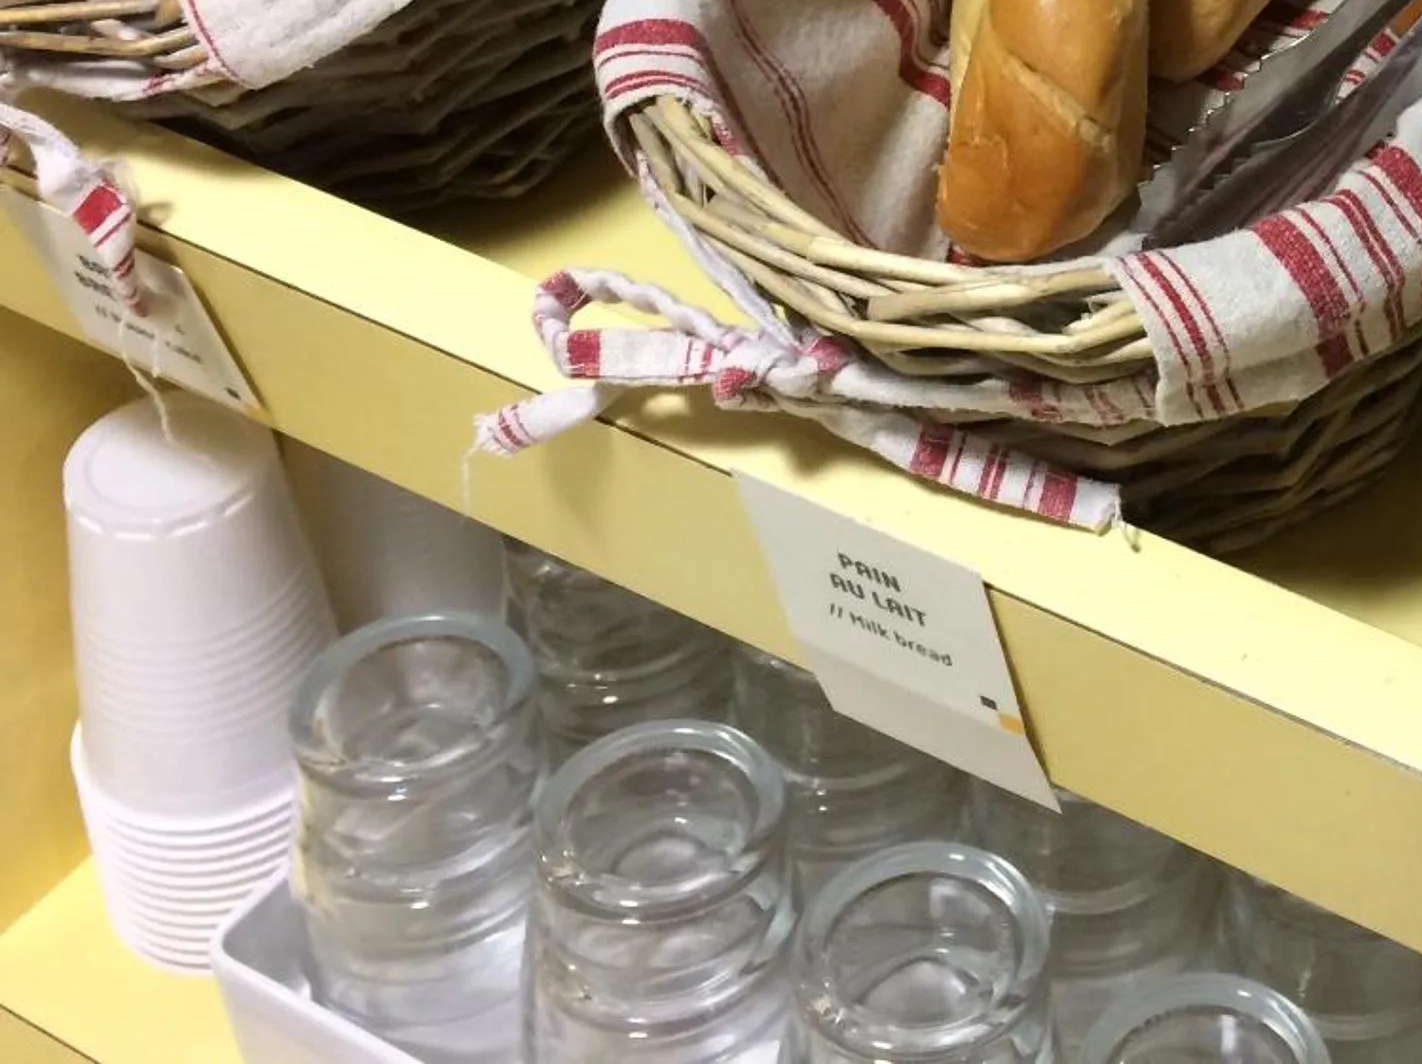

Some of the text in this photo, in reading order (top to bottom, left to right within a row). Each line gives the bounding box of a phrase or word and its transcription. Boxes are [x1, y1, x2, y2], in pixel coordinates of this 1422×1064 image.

[829, 572, 927, 627] AU LAIT
[838, 552, 901, 592] PAIN
[849, 611, 891, 640] Milk
[893, 631, 952, 666] bread
